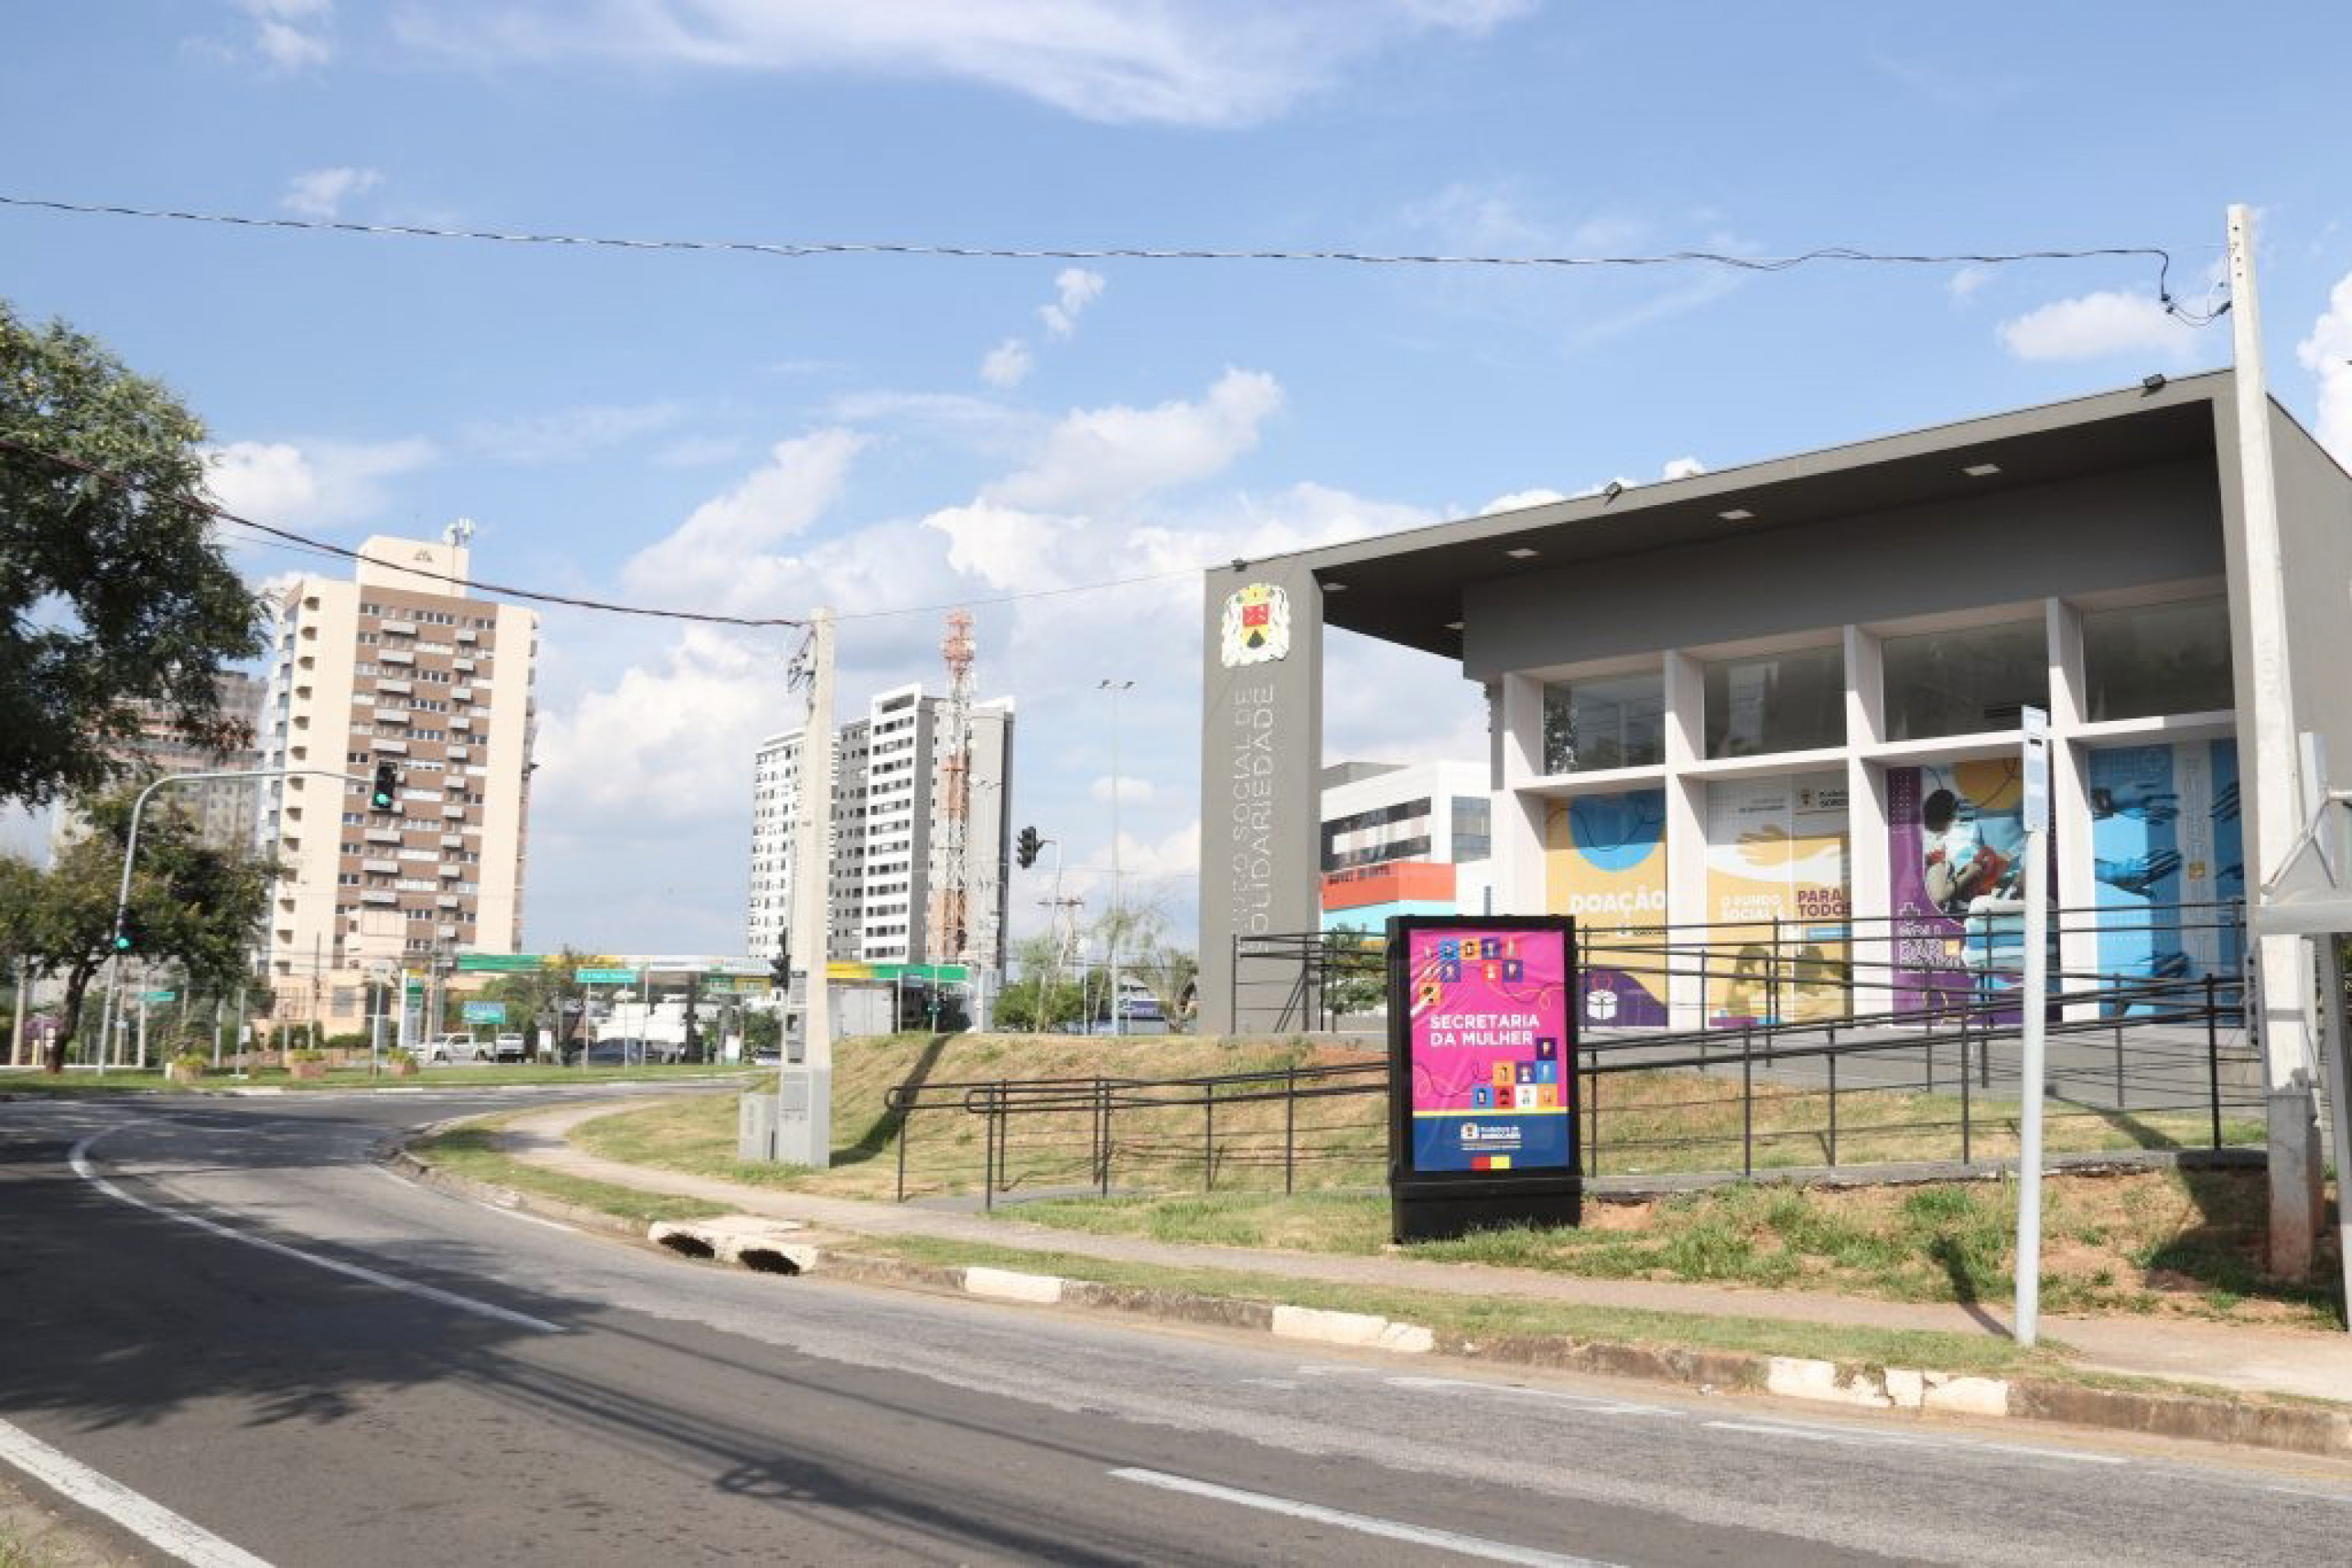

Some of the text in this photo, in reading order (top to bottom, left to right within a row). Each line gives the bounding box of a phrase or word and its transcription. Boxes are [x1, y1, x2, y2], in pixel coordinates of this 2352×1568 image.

[1235, 690, 1250, 725] DE
[1233, 734, 1250, 840] SOCIAL
[1570, 886, 1666, 919] DOAÇÃO
[1798, 889, 1842, 903] PARA
[1431, 1014, 1539, 1029] SECRETARIA
[1431, 1031, 1533, 1047] DA MULHER
